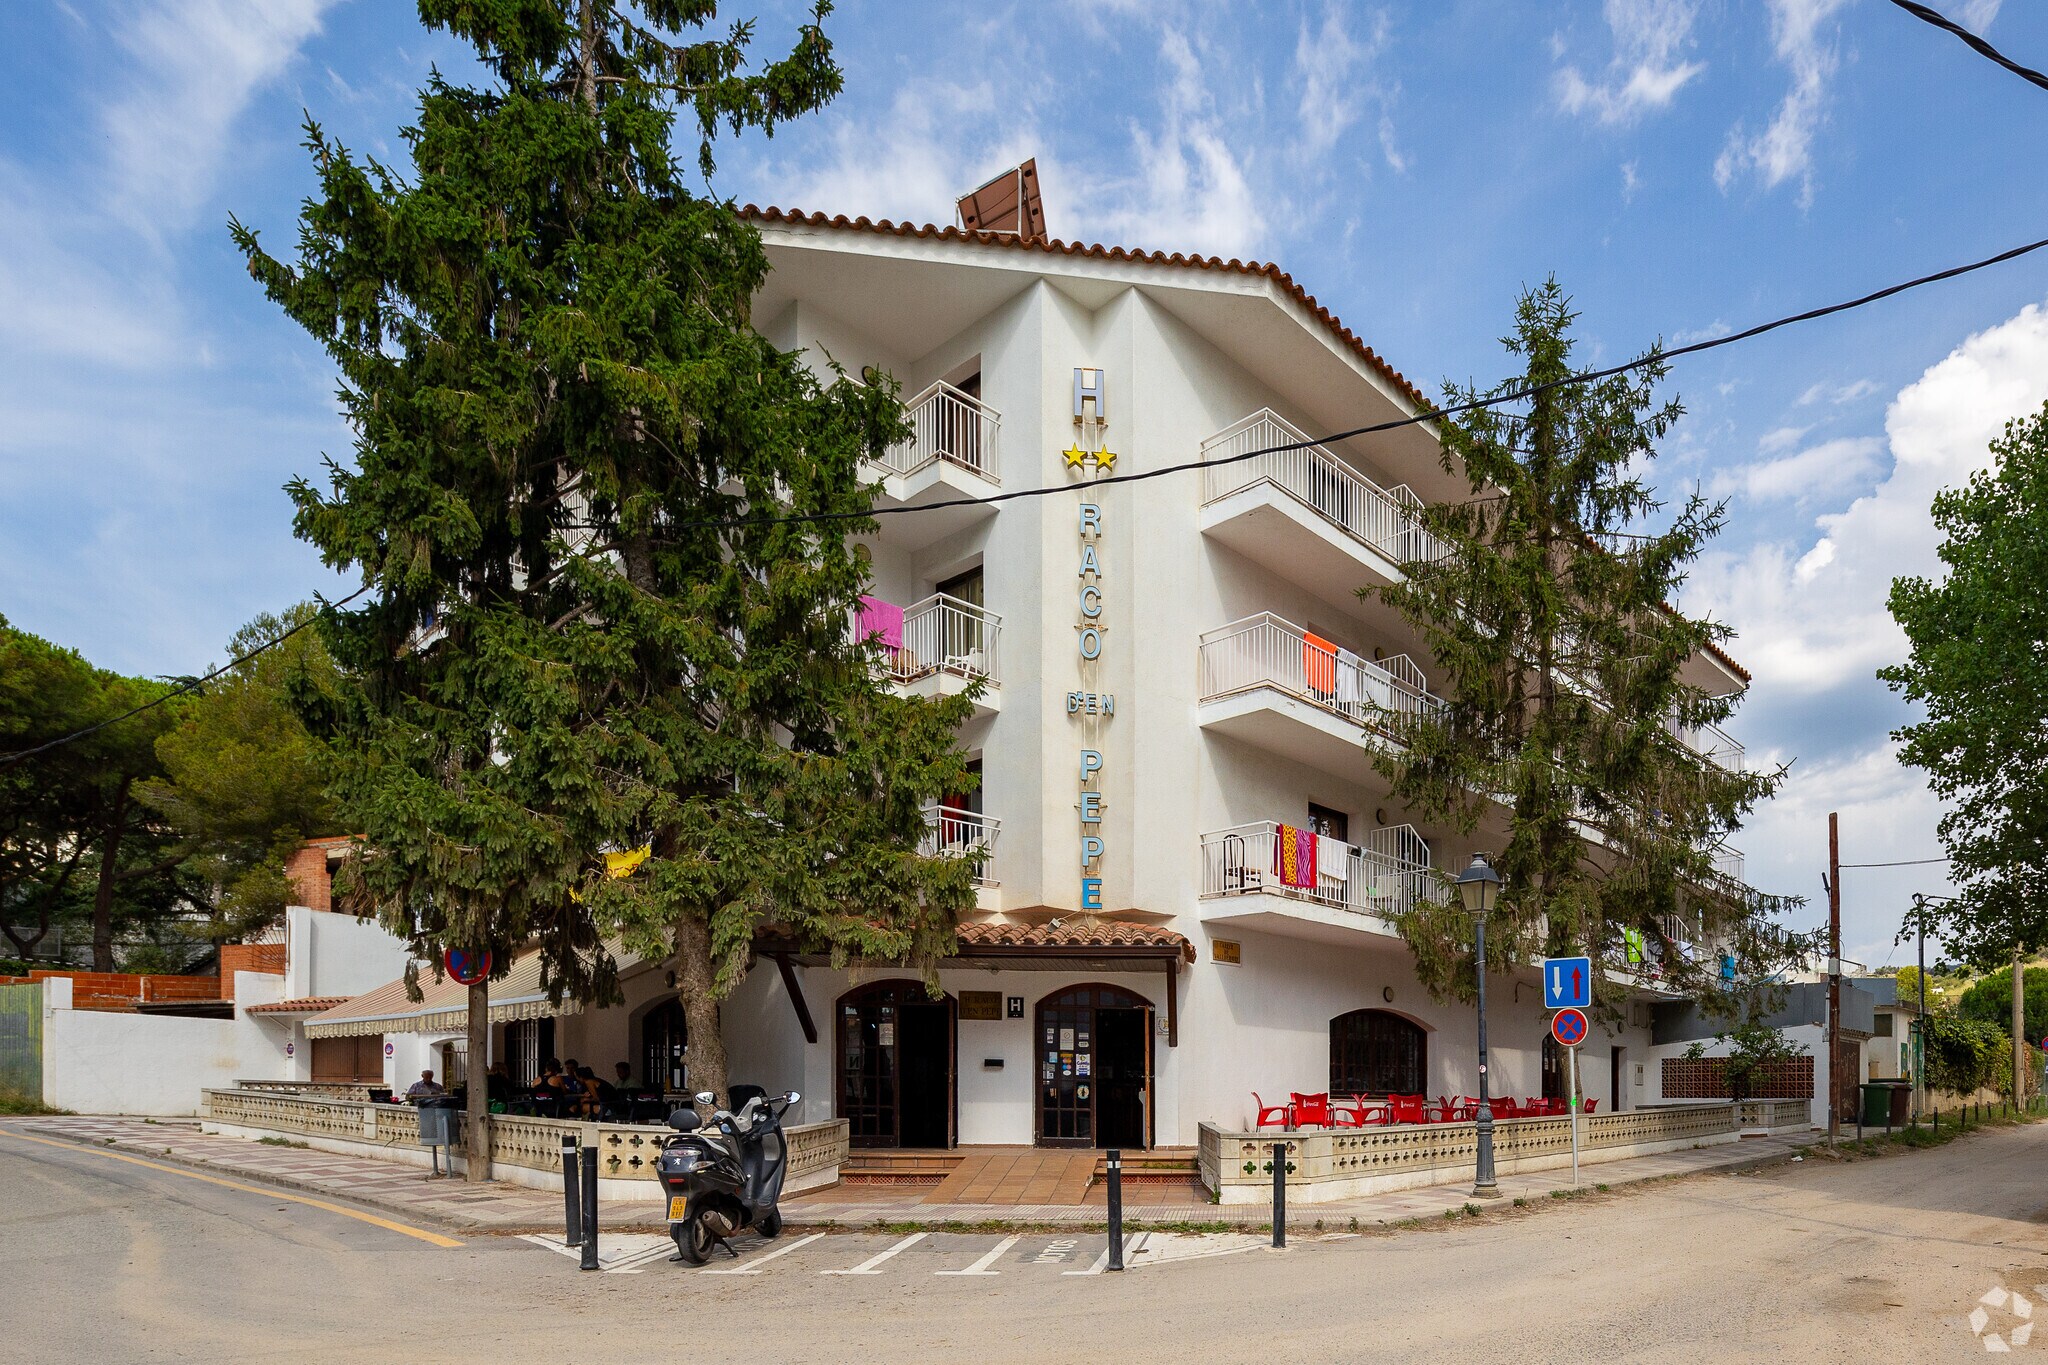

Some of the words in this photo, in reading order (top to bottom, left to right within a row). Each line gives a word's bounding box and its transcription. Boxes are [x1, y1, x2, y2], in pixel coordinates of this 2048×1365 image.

[1073, 367, 1104, 419] H
[1078, 503, 1102, 661] RACO
[1081, 750, 1105, 909] PEPE
[354, 1019, 409, 1033] RESTAURANT
[522, 1001, 552, 1017] PEPE
[1010, 999, 1021, 1011] H
